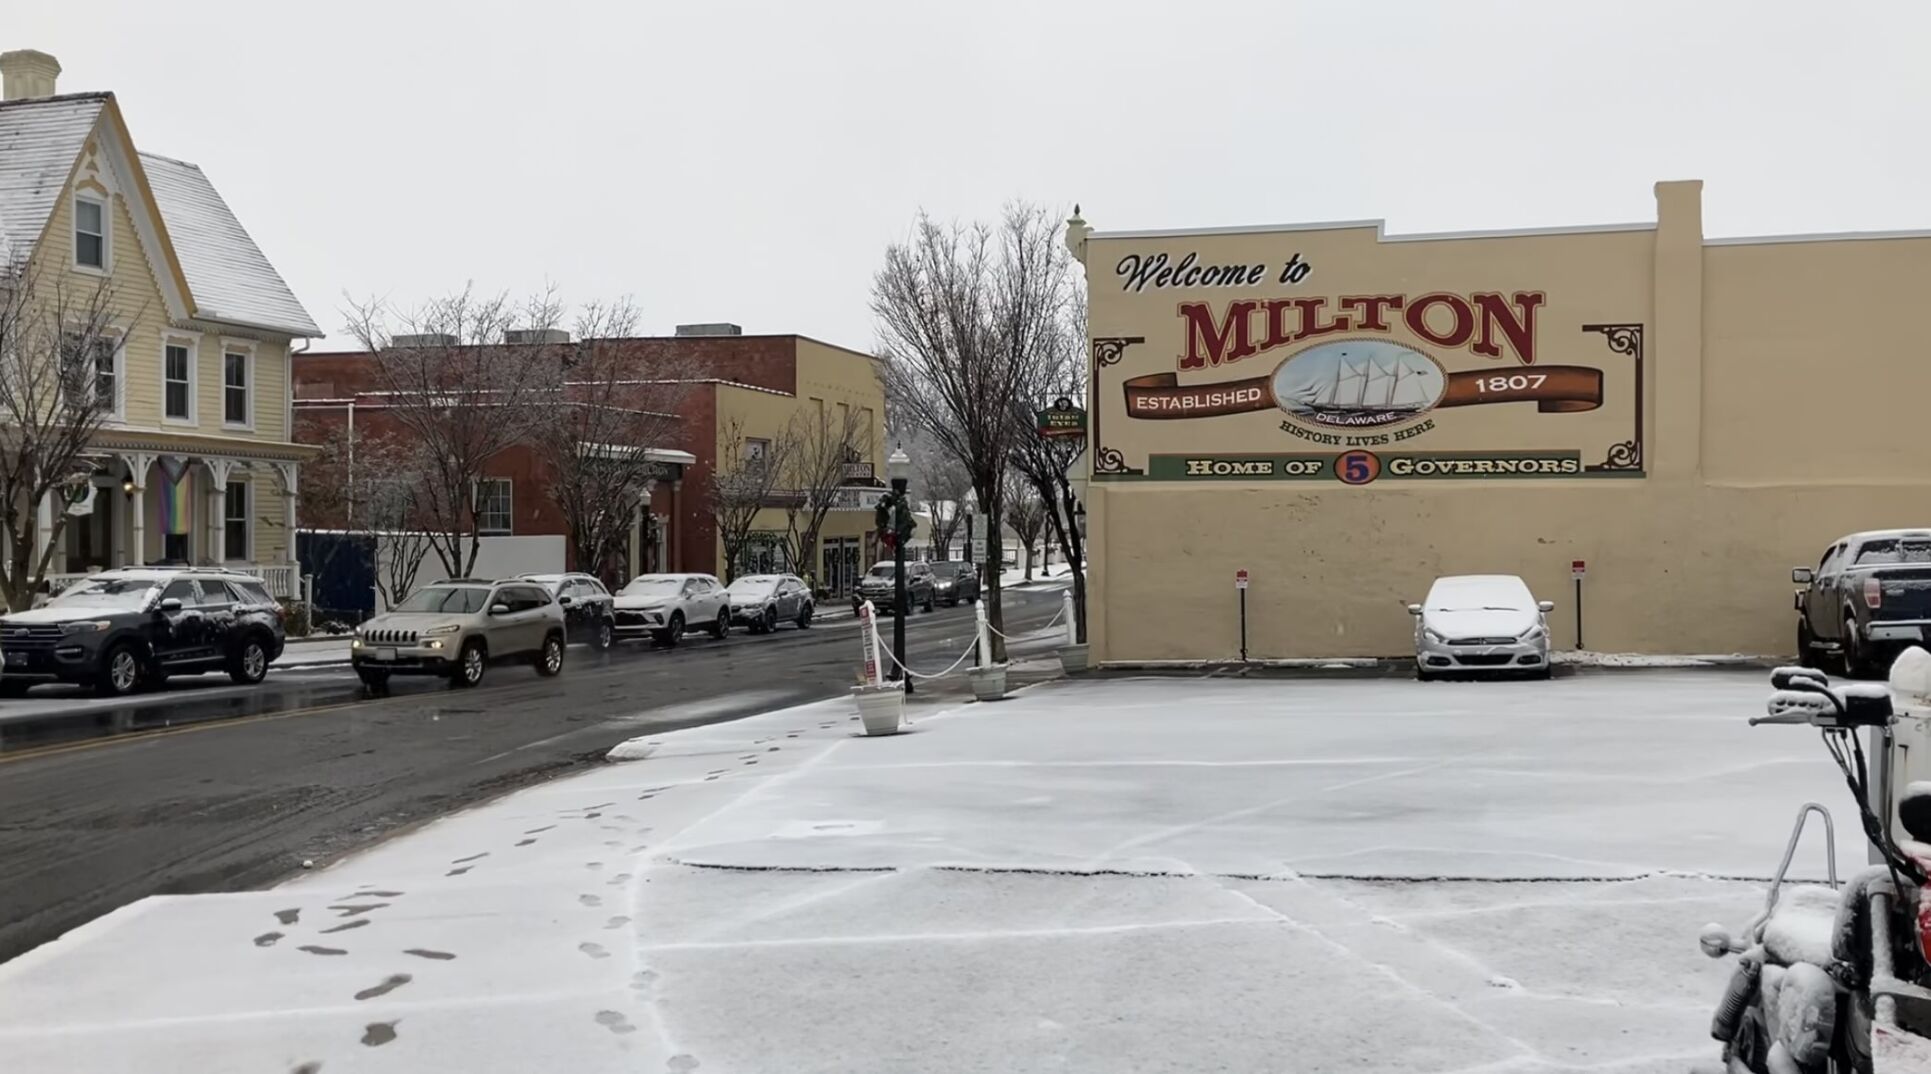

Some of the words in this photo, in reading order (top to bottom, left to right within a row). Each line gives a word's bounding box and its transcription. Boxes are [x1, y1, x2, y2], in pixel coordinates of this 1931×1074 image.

[1116, 252, 1267, 293] Welcome
[1279, 253, 1312, 287] to
[1177, 291, 1547, 372] MILTON
[1136, 387, 1261, 410] ESTABLISHED
[1475, 374, 1548, 393] 1807
[1279, 420, 1341, 446] HISTORY
[1345, 434, 1389, 447] LIVES
[1393, 418, 1436, 441] HERE
[1315, 411, 1397, 425] DELAWARE
[1186, 460, 1273, 475] HOME
[1284, 461, 1323, 475] OF
[1344, 455, 1370, 482] 5
[1389, 458, 1580, 475] GOVERNORS
